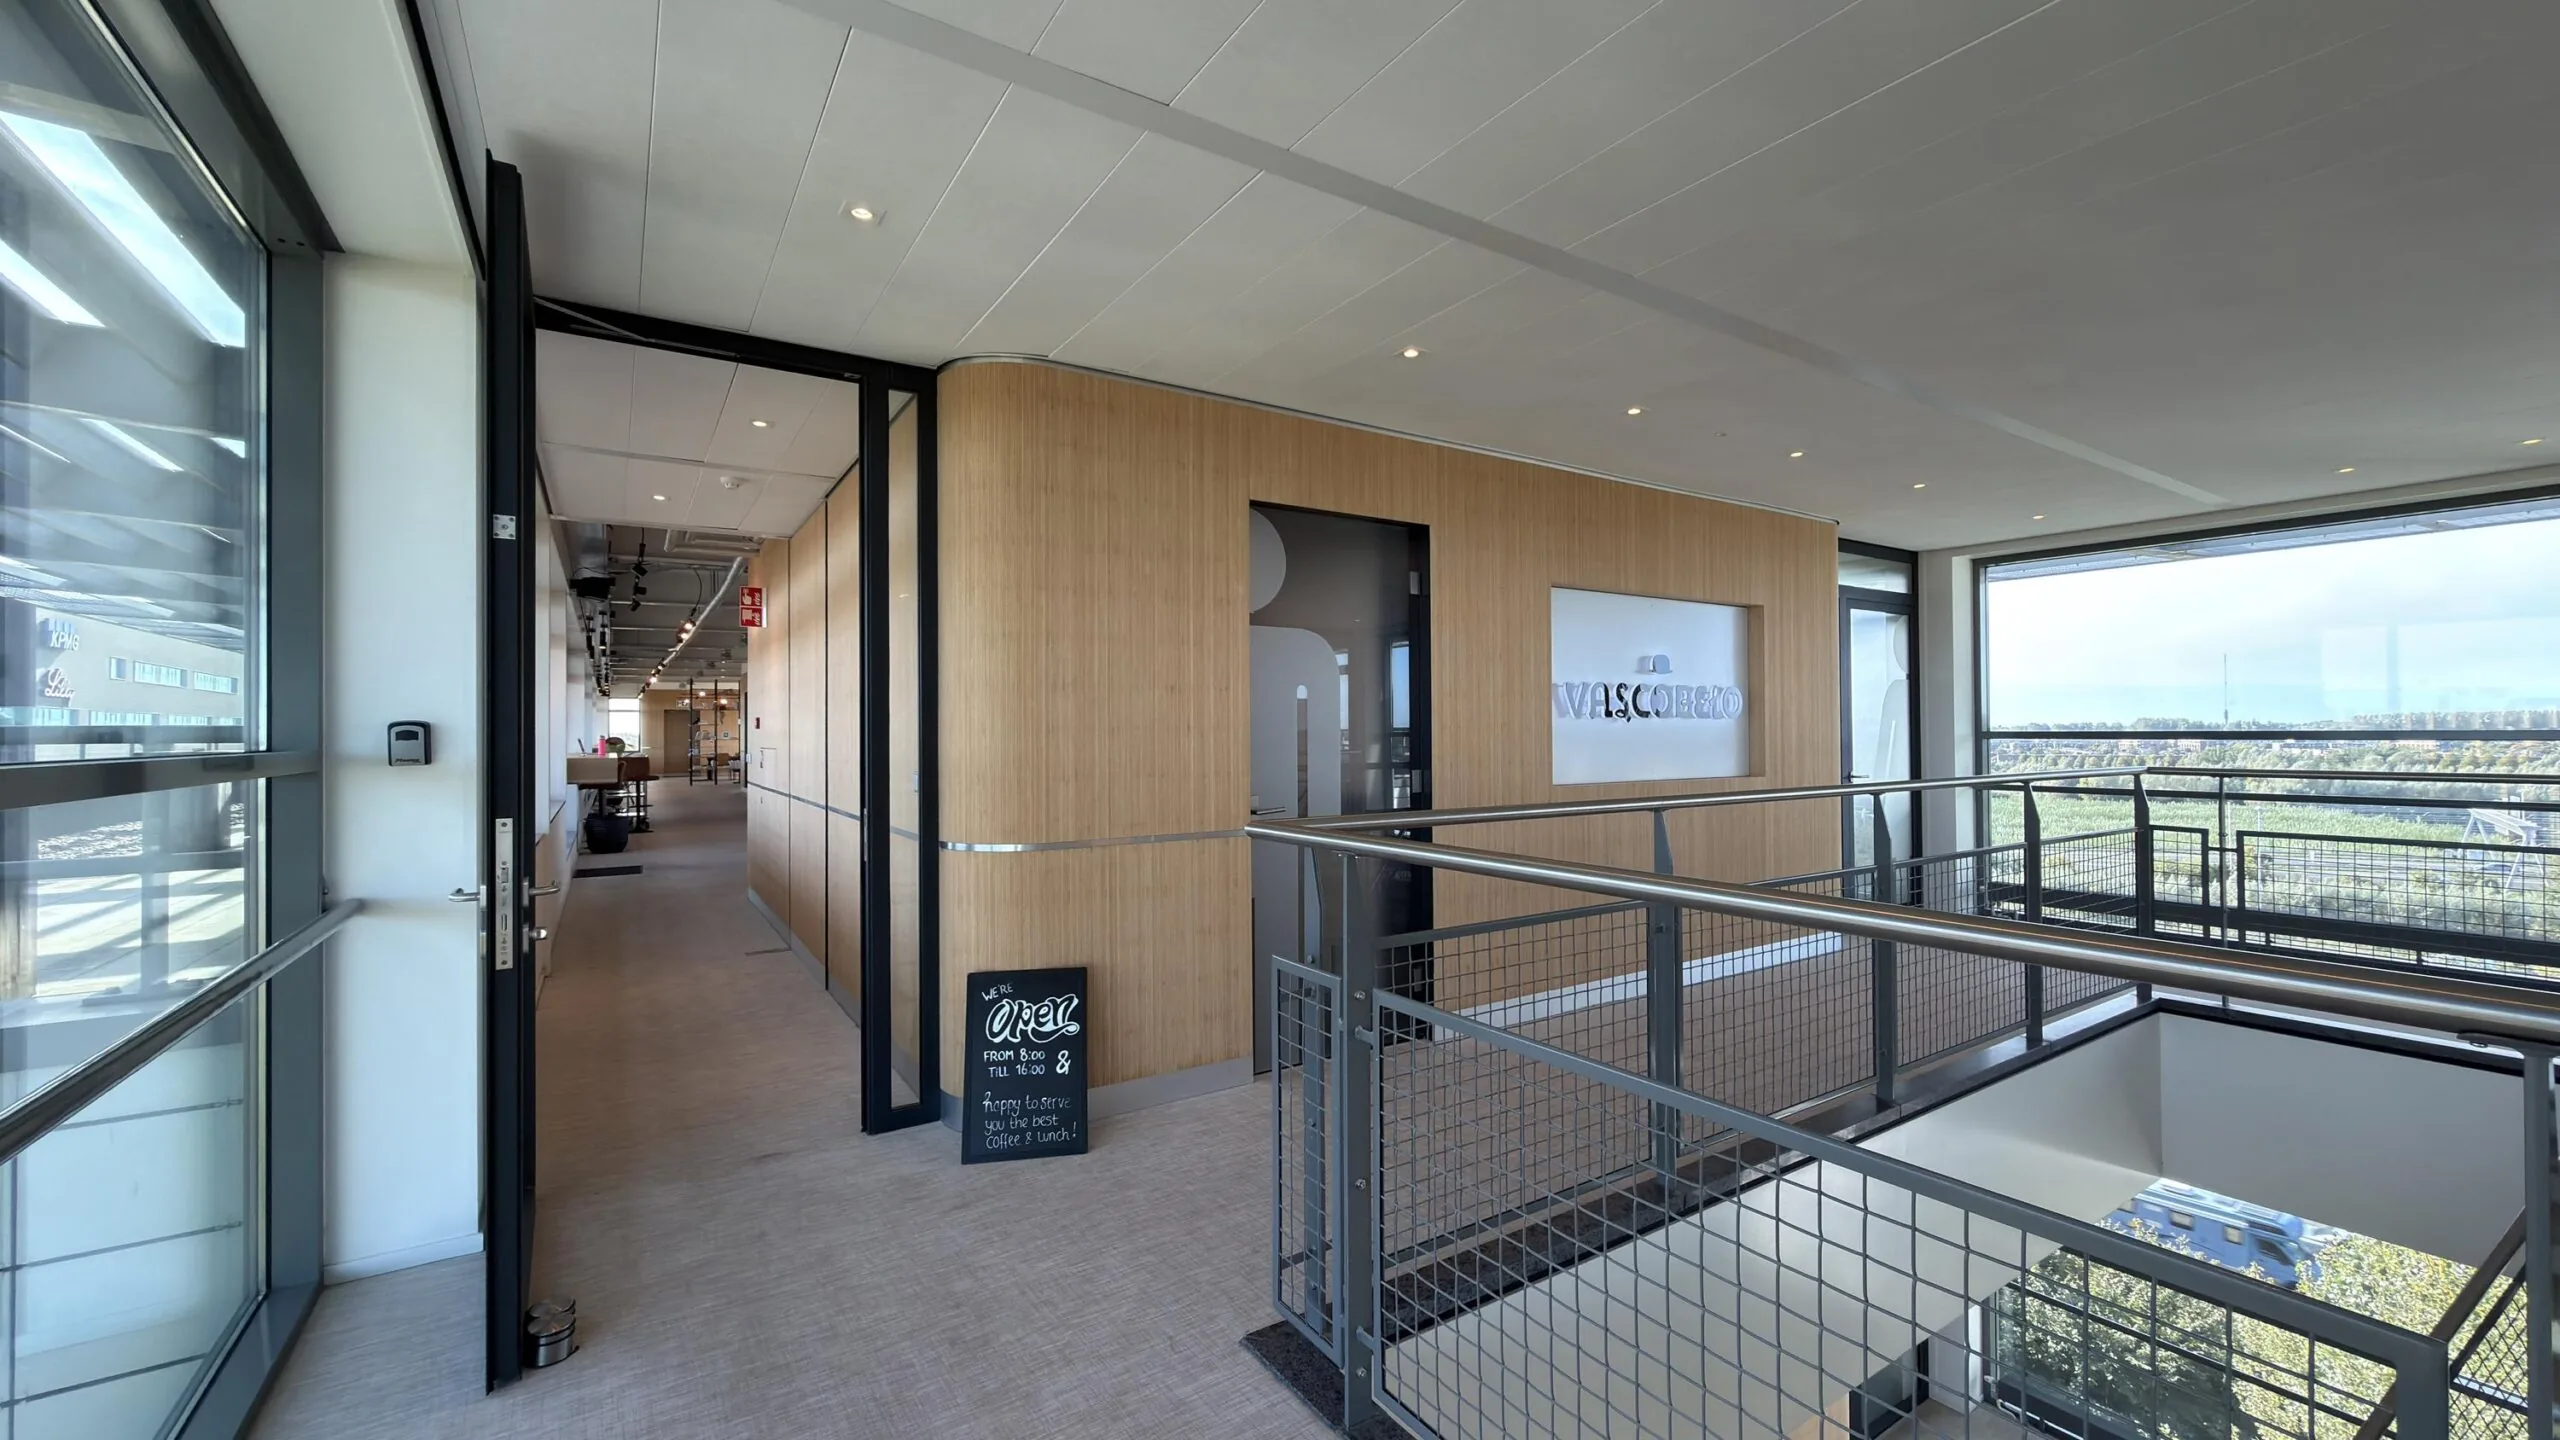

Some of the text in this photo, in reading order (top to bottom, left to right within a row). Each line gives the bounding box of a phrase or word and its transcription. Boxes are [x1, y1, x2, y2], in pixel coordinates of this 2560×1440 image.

[51, 630, 79, 650] KPMG
[981, 983, 1014, 1001] WE'RE
[984, 1048, 1045, 1062] FROM 8:00
[1056, 1050, 1071, 1075] &
[1016, 1063, 1045, 1075] 16:00
[982, 1091, 1072, 1117] happy to serve
[985, 1114, 1059, 1135] you the best
[986, 1133, 1020, 1149] coffee
[1025, 1132, 1032, 1145] &
